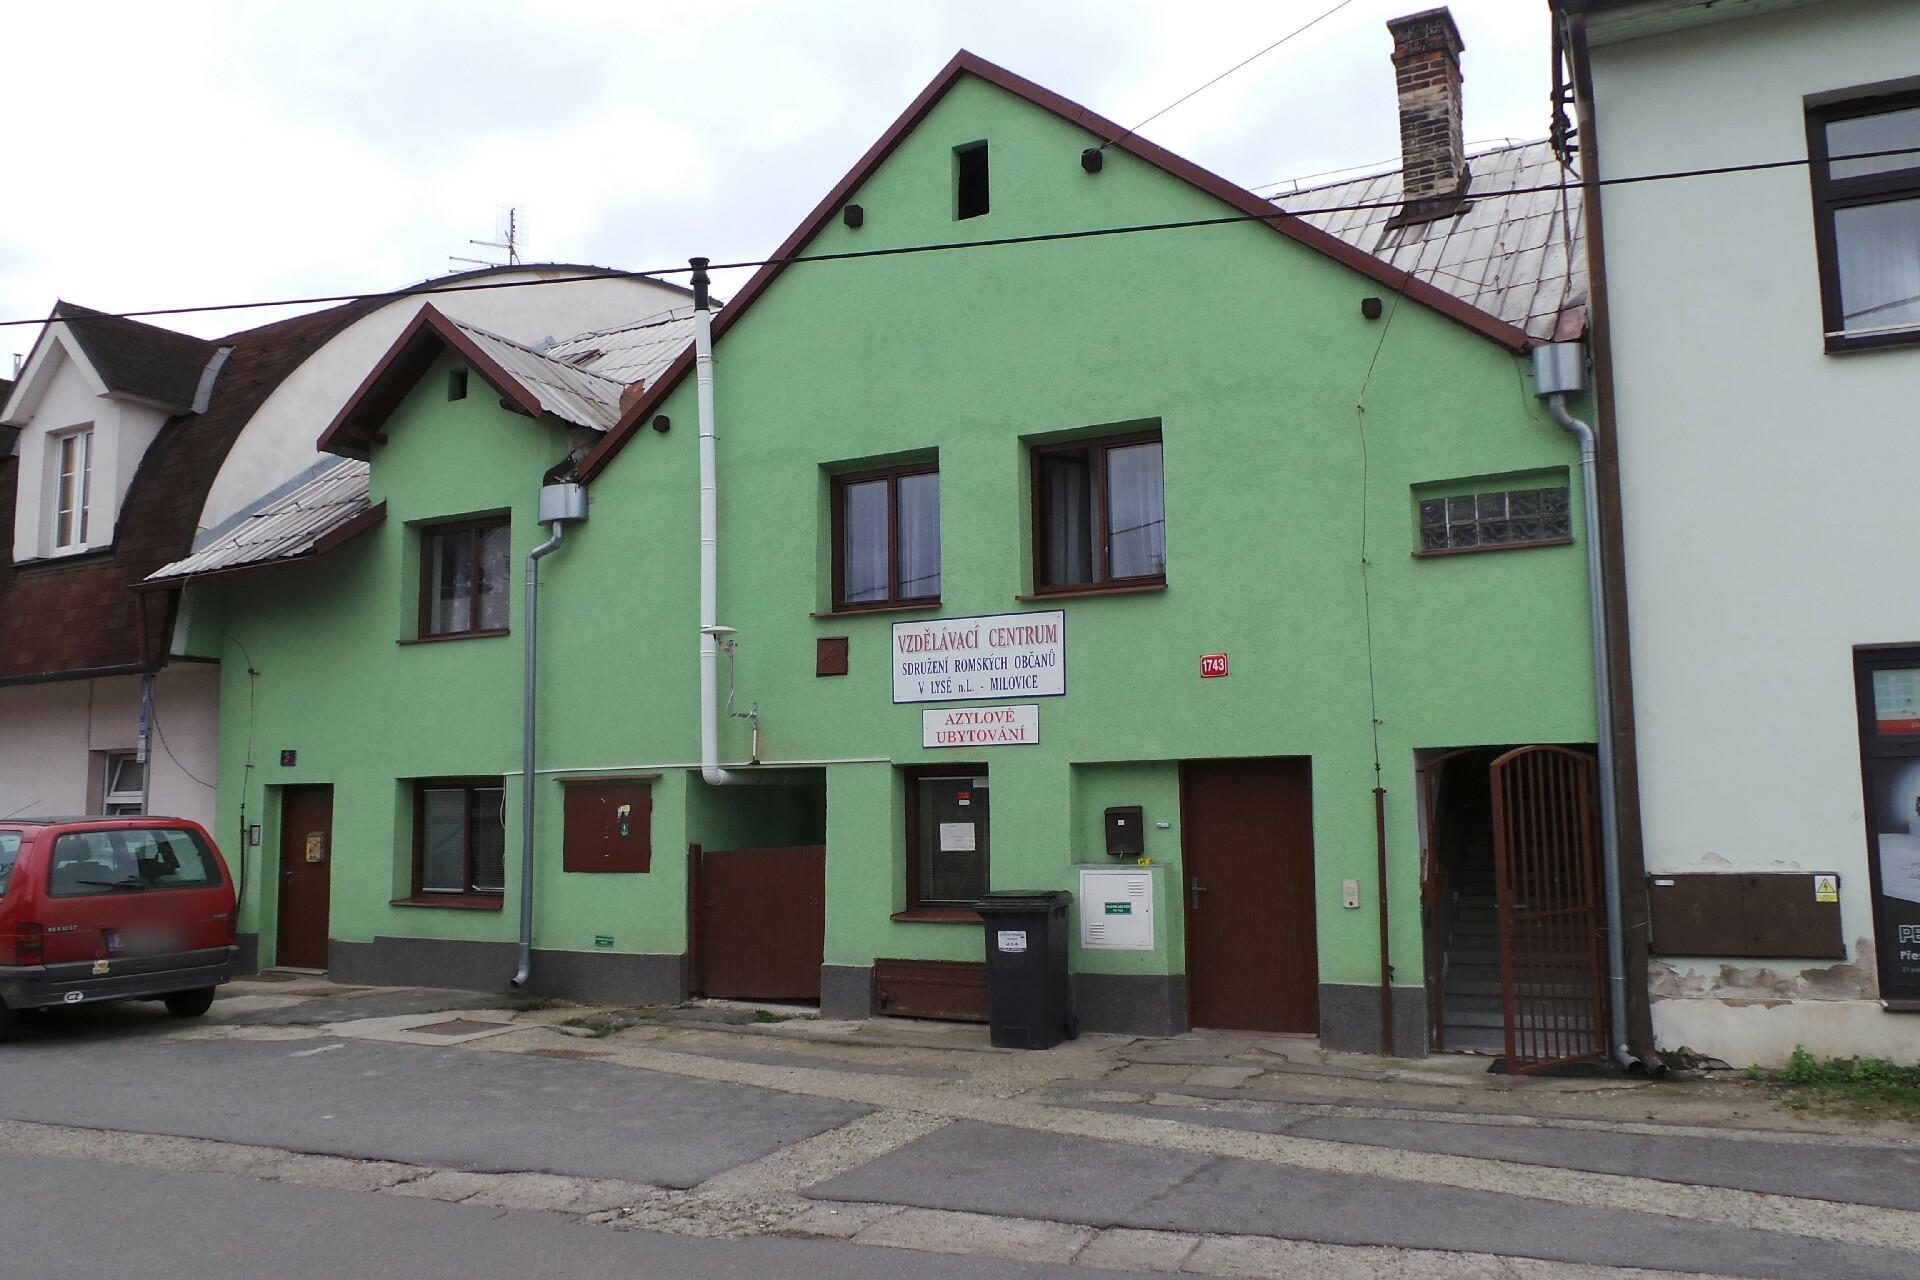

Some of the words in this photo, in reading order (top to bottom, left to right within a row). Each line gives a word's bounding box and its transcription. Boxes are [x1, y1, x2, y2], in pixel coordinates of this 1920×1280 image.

[898, 624, 979, 653] VZDĚLÁVACÍ
[988, 624, 1057, 647] CENTRUM
[902, 656, 949, 675] SDRUŽENÍ
[954, 653, 1008, 673] ROMSKÝCH
[1014, 649, 1055, 669] OBČANŮ
[1202, 658, 1224, 672] 1743
[918, 681, 924, 694] V
[931, 676, 952, 694] LYSÉ
[958, 680, 975, 693] n.L.
[990, 675, 1038, 690] MILOVICE
[945, 708, 1014, 725] AZYLOVÉ
[936, 725, 1025, 743] UBYTOVÁNÍ
